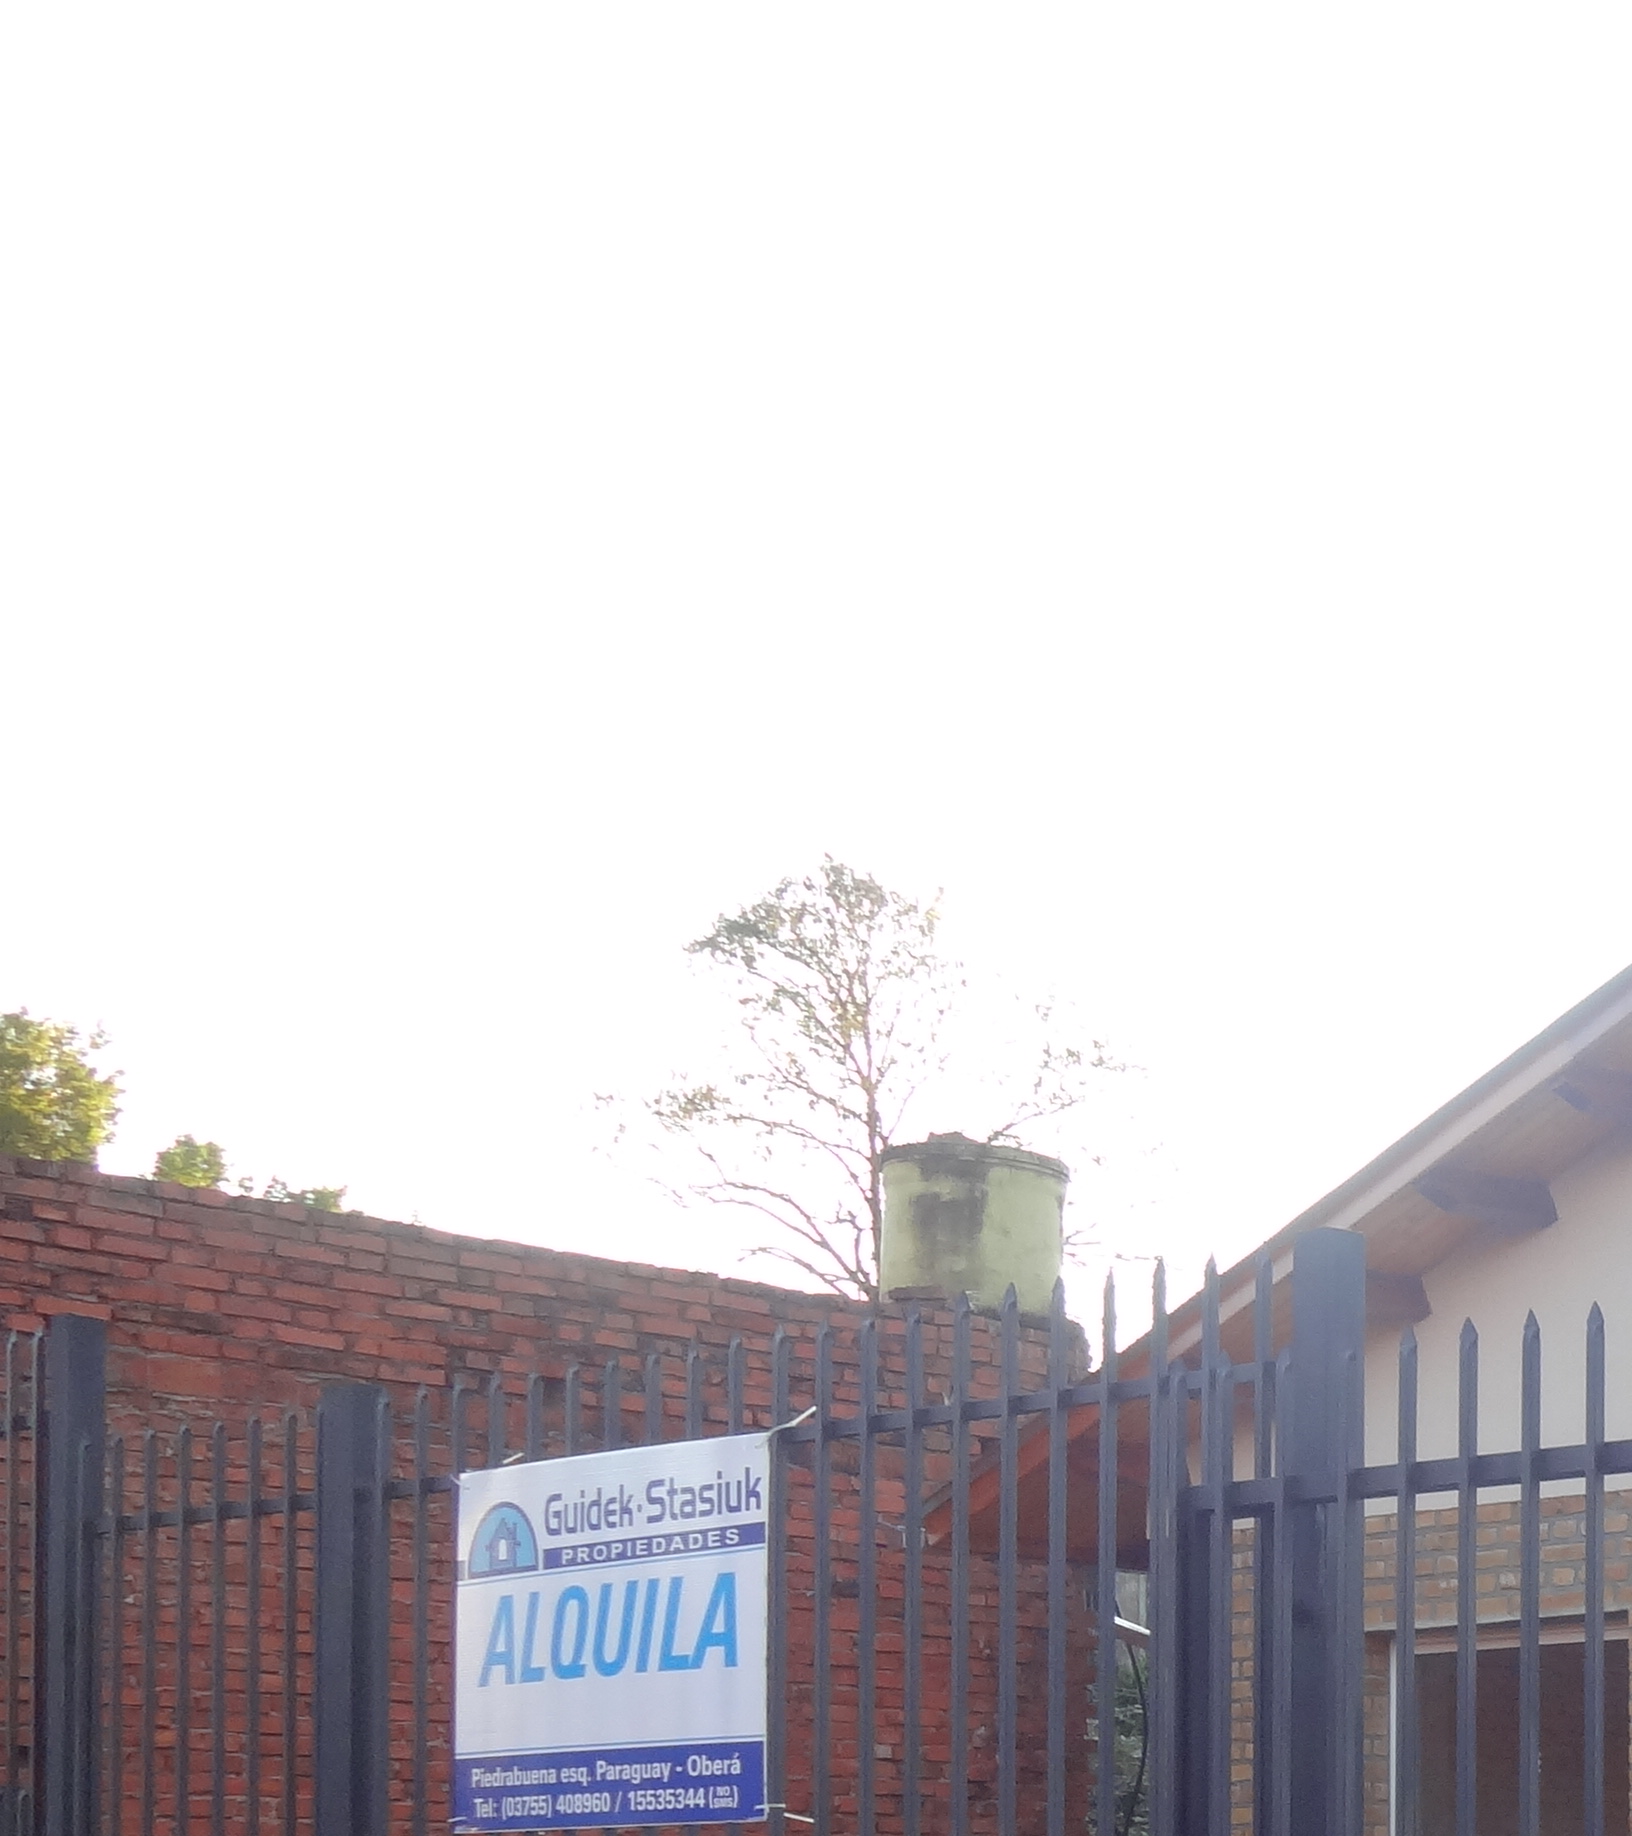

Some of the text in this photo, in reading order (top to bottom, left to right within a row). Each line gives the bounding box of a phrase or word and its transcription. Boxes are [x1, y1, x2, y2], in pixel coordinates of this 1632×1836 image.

[561, 1528, 741, 1566] PROPIEDADES
[478, 1571, 739, 1688] ALQUILA
[471, 1766, 557, 1788] Piedrabuena
[560, 1766, 592, 1787] esq.
[596, 1760, 671, 1785] Paraguay
[687, 1752, 741, 1777] Oberá
[473, 1798, 498, 1819] Tel:
[501, 1795, 552, 1821] (03755)
[556, 1792, 611, 1815] 408960
[628, 1787, 706, 1811] 15535344
